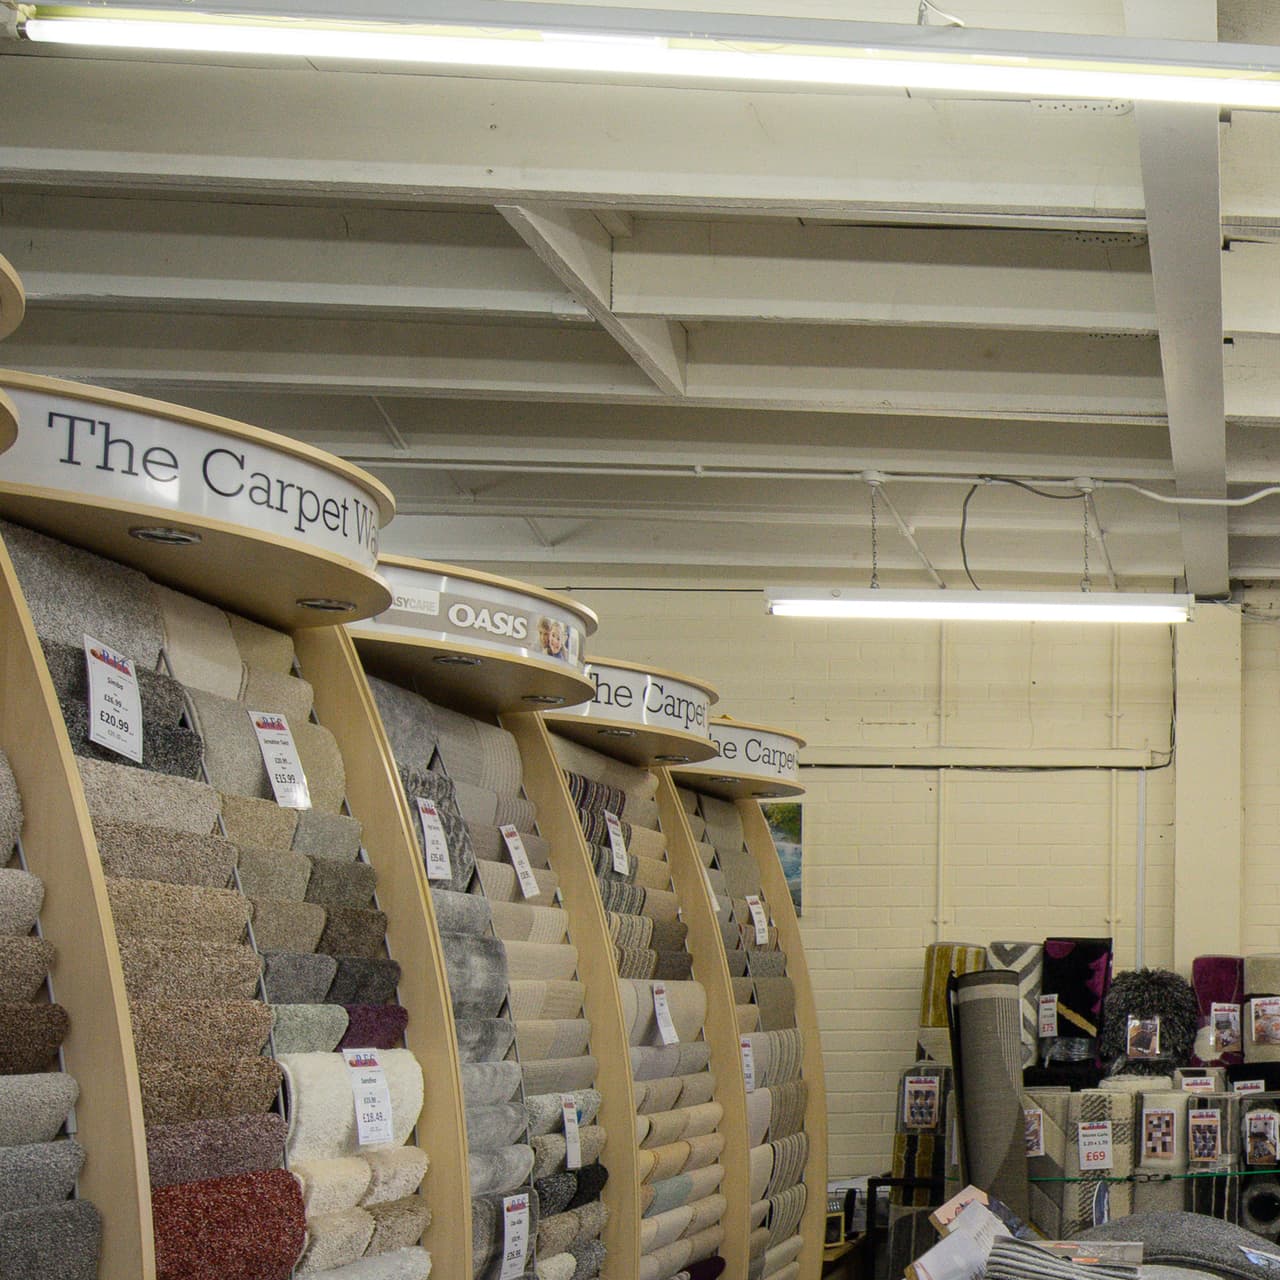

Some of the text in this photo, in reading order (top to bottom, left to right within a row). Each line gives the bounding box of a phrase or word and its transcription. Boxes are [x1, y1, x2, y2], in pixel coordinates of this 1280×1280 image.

[48, 411, 180, 483] The
[202, 448, 350, 537] Carpet
[448, 602, 529, 640] OASIS
[588, 672, 707, 729] he Carpet
[100, 710, 129, 733] £20.99
[709, 733, 796, 774] he Carpet
[275, 773, 296, 784] £15.99
[1085, 1151, 1106, 1161] £69
